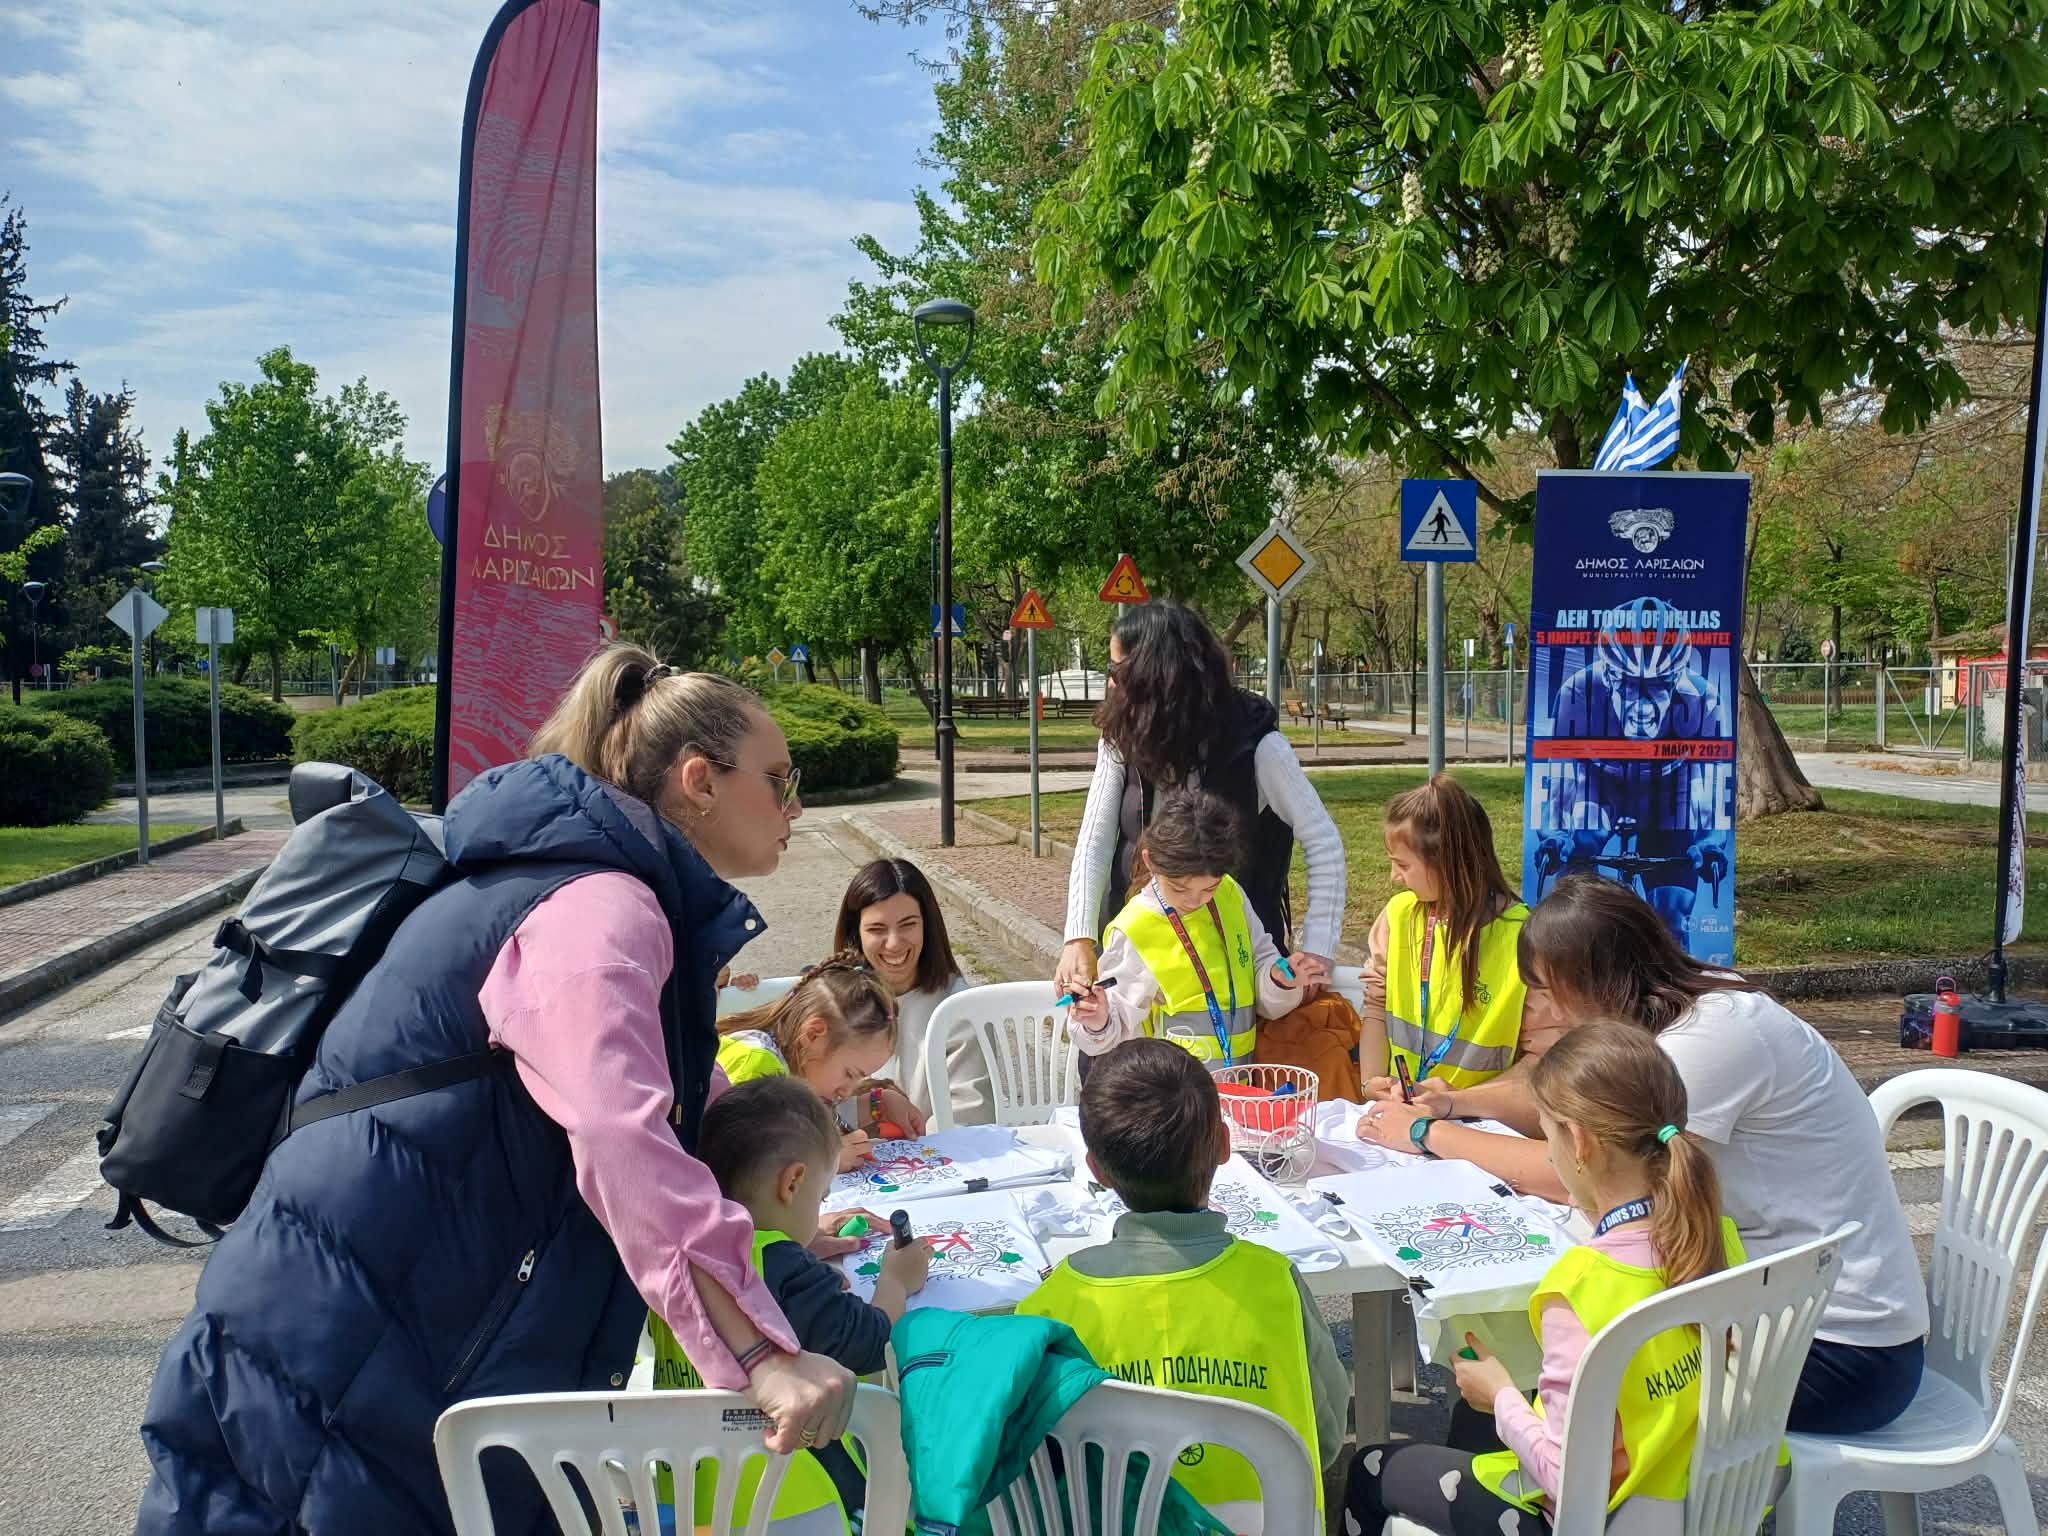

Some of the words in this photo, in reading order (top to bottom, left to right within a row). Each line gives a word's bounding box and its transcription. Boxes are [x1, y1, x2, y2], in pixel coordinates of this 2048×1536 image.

[1575, 558, 1629, 570] ΔΗΜΟΣ
[1634, 559, 1705, 571] ΛΑΡΙΣΑΙΩΝ
[1556, 609, 1589, 628] ΔΕΗ
[1592, 609, 1637, 628] TOUR
[1641, 610, 1661, 628] OF
[1663, 610, 1721, 629] HELLAS
[1536, 632, 1545, 645] 5
[1605, 1207, 1630, 1229] DAYS
[1629, 1202, 1646, 1217] 20
[1162, 1355, 1268, 1390] ΠΟΔΗΛΑΣΙΑΣ
